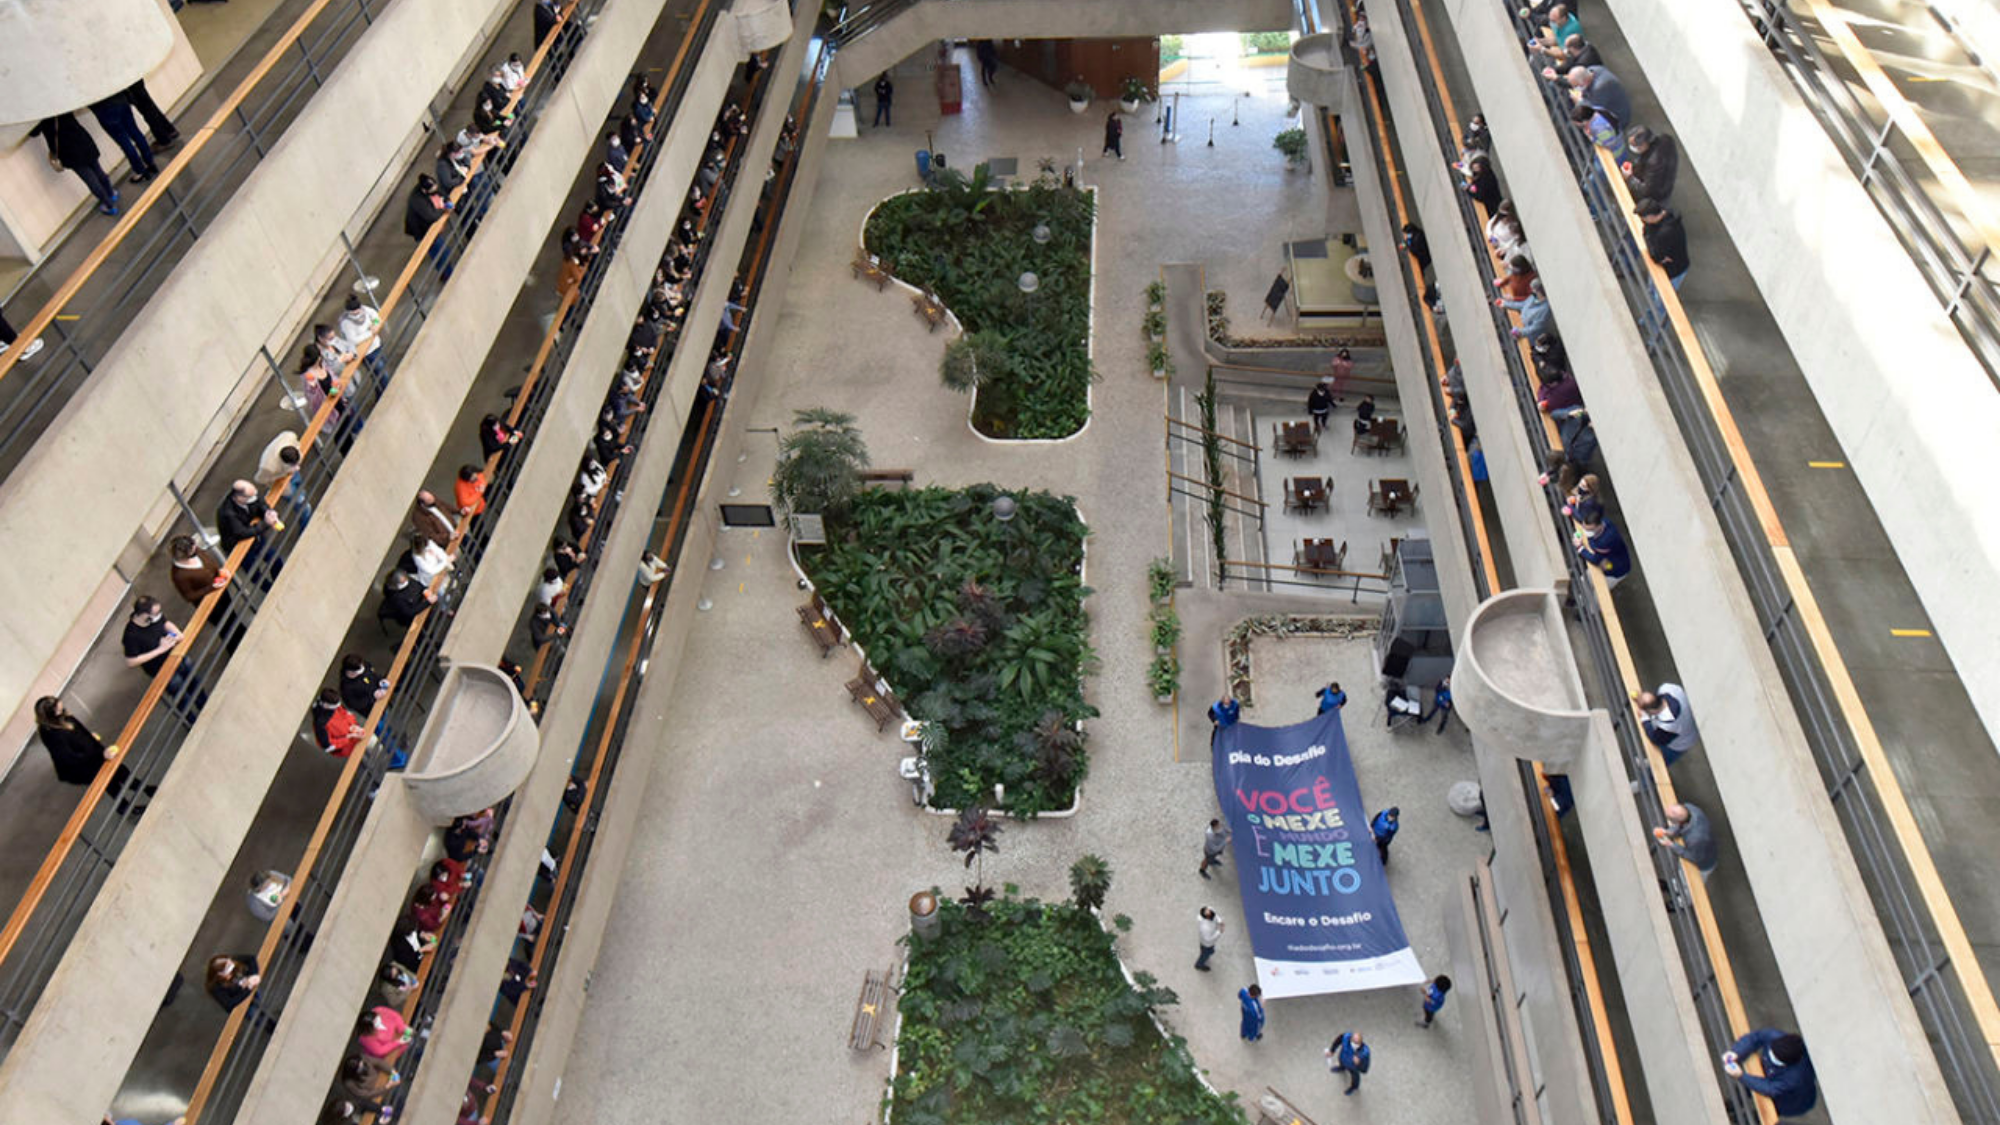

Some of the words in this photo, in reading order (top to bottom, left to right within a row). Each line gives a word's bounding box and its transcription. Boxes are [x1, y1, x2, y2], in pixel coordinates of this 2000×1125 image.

[1229, 750, 1252, 764] Dia
[1254, 753, 1271, 766] do
[1273, 745, 1326, 766] Desafio
[1237, 775, 1337, 815] VOCÊ
[1262, 808, 1344, 832] MEXE
[1251, 824, 1271, 857] E
[1273, 840, 1355, 868] MEXE
[1280, 828, 1349, 843] MUNDO
[1258, 865, 1362, 896] JUNTO
[1264, 911, 1305, 926] Encare
[1308, 916, 1318, 926] o
[1320, 912, 1372, 926] Desafio
